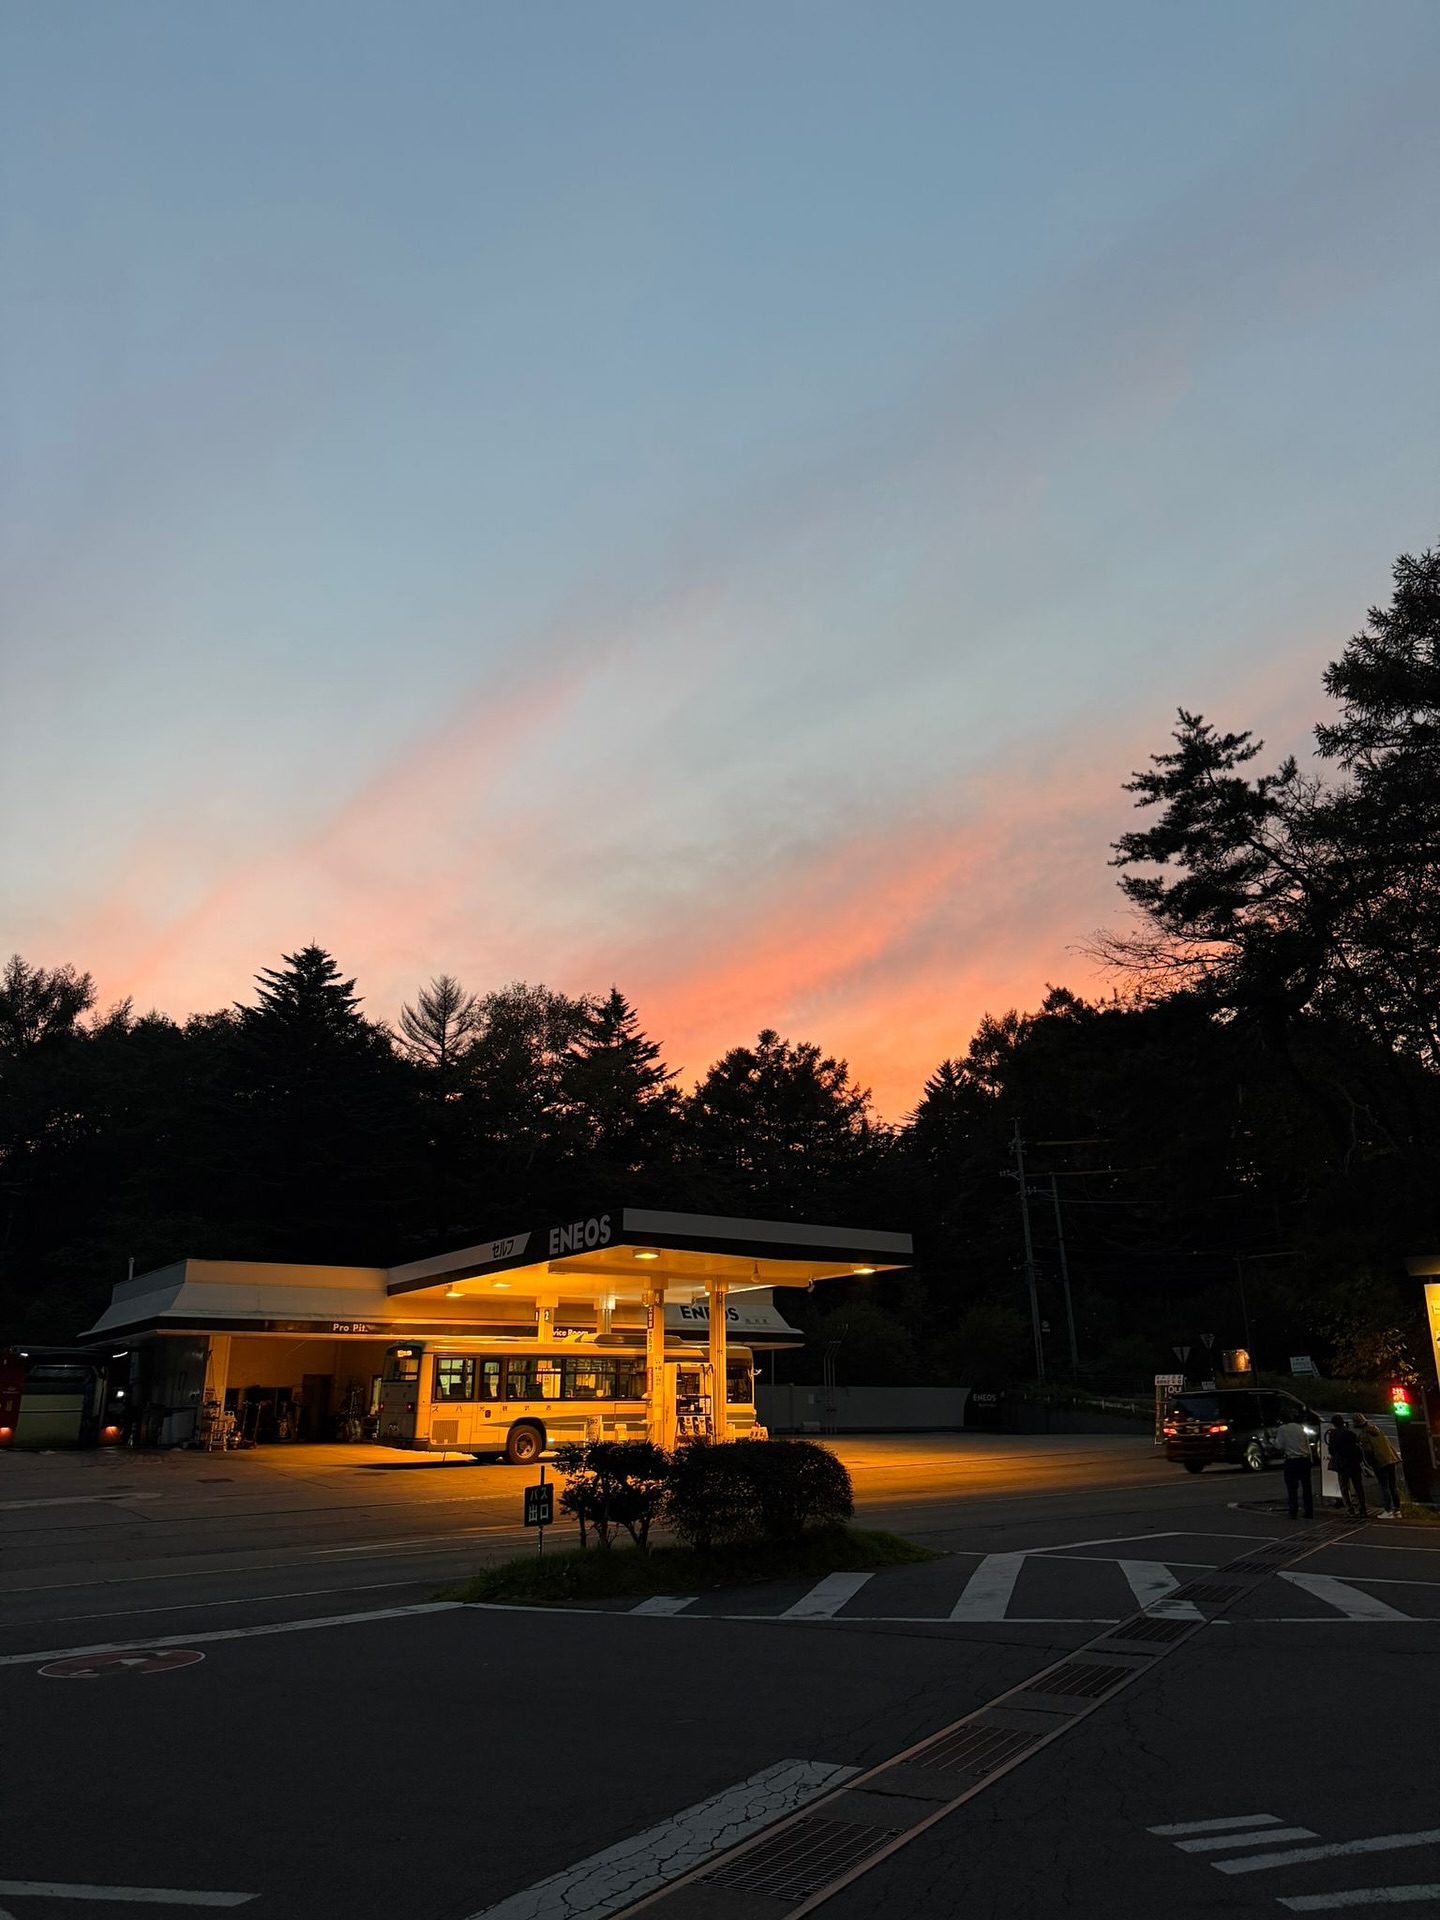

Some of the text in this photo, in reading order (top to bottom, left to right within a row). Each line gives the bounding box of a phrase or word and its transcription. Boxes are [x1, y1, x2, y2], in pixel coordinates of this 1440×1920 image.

[549, 1214, 612, 1256] ENEOS
[492, 1239, 514, 1258] セルフ
[680, 1306, 739, 1321] ENS
[333, 1323, 349, 1332] Pro
[973, 1393, 997, 1402] ENEOS
[528, 1503, 549, 1523] 出口
